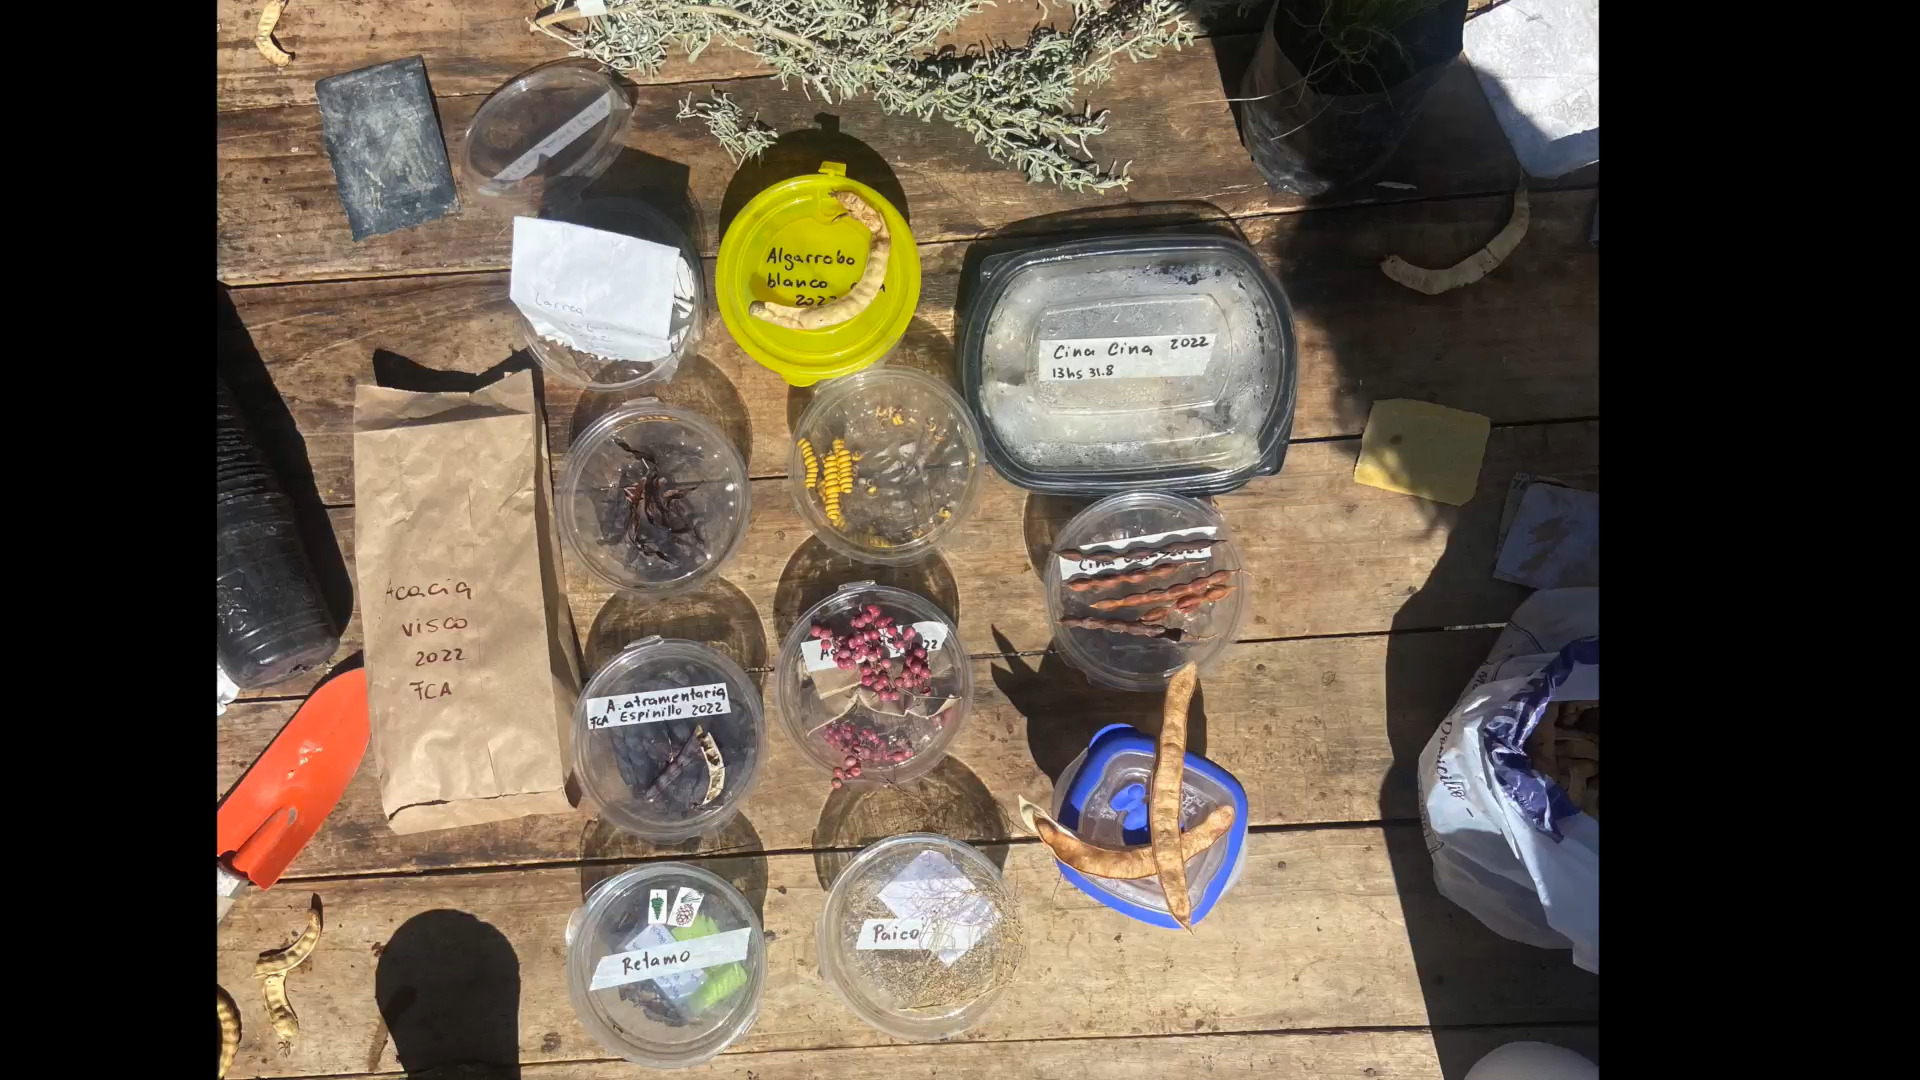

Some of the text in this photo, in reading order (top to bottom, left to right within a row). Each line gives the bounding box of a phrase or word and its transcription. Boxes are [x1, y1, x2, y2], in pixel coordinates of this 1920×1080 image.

[766, 247, 856, 271] Algarrobo
[766, 272, 828, 289] blanco
[535, 292, 584, 316] Larrea
[1053, 336, 1209, 360] Cina Cina 2022
[1052, 364, 1114, 380] 13hs 31.8
[385, 577, 472, 605] Acacia
[401, 616, 468, 637] visco
[415, 648, 467, 667] 2022
[409, 680, 453, 701] FCA
[606, 685, 726, 714] A. atramentaria
[589, 701, 724, 729] FCA Espinillo 2022
[872, 924, 920, 944] Paico
[621, 950, 691, 976] Retamo
